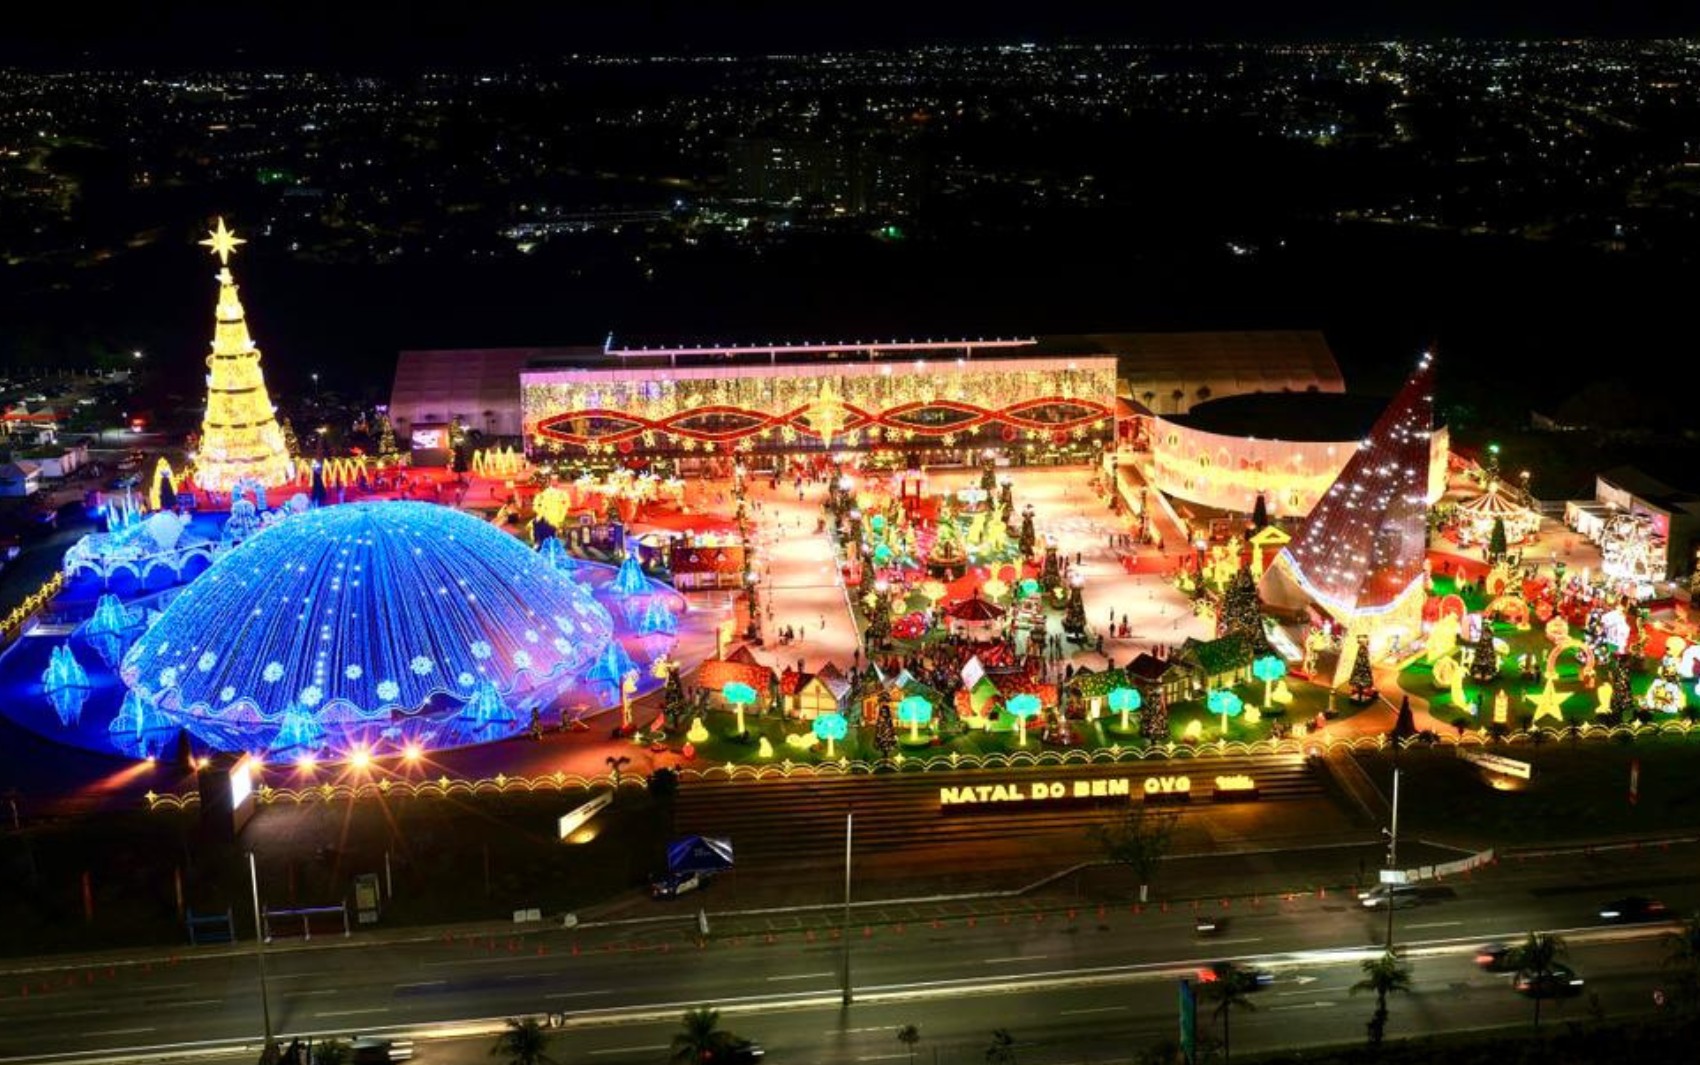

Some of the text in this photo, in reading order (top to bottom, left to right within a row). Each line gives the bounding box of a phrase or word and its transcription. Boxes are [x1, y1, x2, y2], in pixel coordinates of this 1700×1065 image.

[941, 783, 1024, 804] NATAL
[1032, 781, 1065, 799] DO
[1074, 778, 1129, 797] BEM
